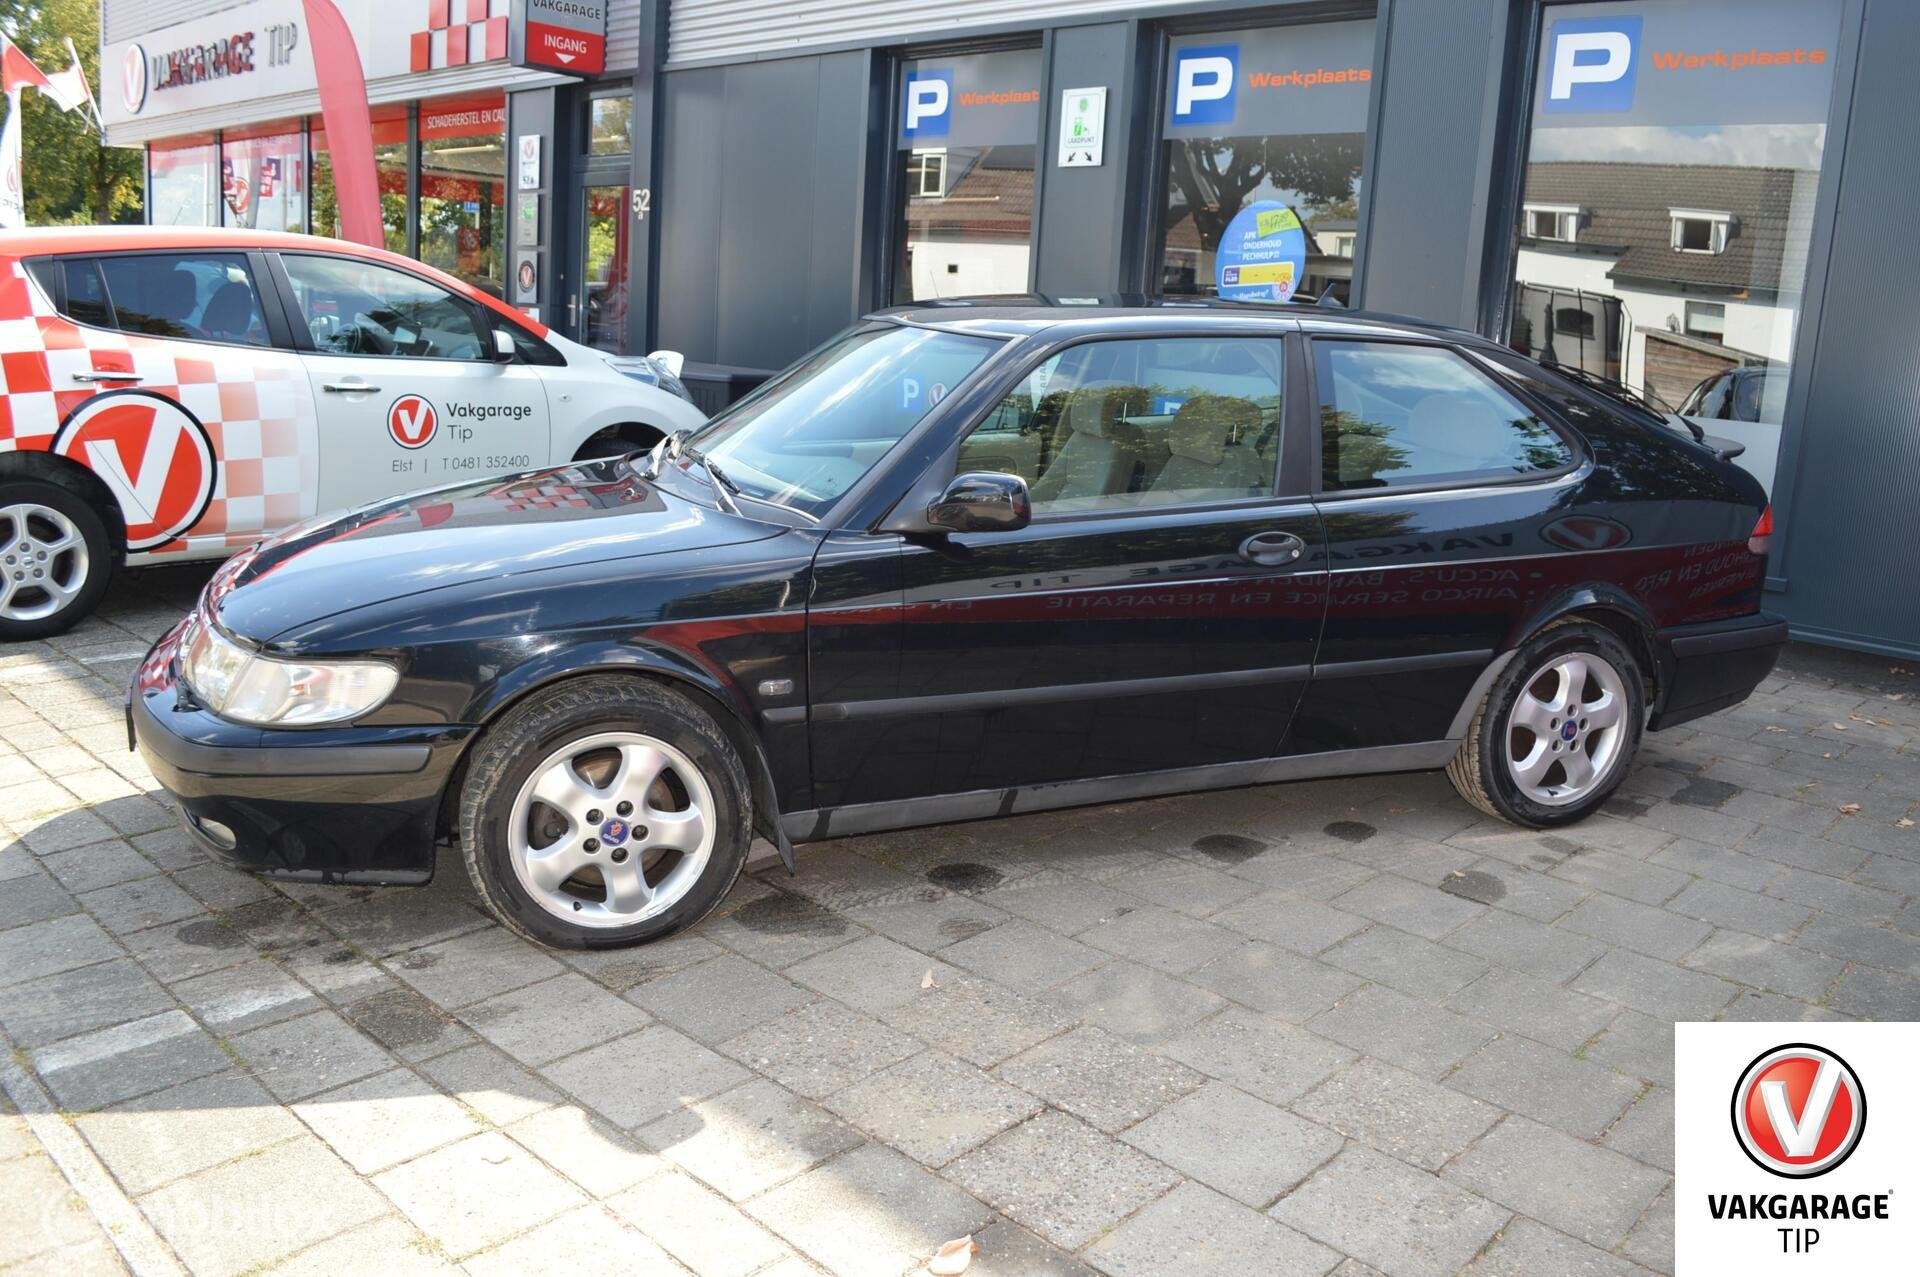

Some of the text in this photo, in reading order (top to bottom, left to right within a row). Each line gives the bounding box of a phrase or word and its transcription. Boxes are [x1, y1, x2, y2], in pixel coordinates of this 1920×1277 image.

[533, 0, 601, 20] VAKGARAGE
[264, 22, 298, 67] TIP
[544, 33, 588, 54] INGANG
[1550, 31, 1631, 100] P
[1652, 48, 1827, 71] Werkplaats
[1176, 56, 1233, 115] P
[1248, 68, 1373, 88] Werkplaats
[907, 79, 949, 129] P
[427, 111, 480, 129] SCHADEHERSTEL
[481, 110, 492, 124] EN
[632, 188, 650, 212] 52
[1243, 240, 1282, 250] ONDERHOUD
[446, 402, 532, 421] Vakgarage
[447, 425, 473, 443] Tip
[392, 455, 530, 472] Elst T 0481 352400
